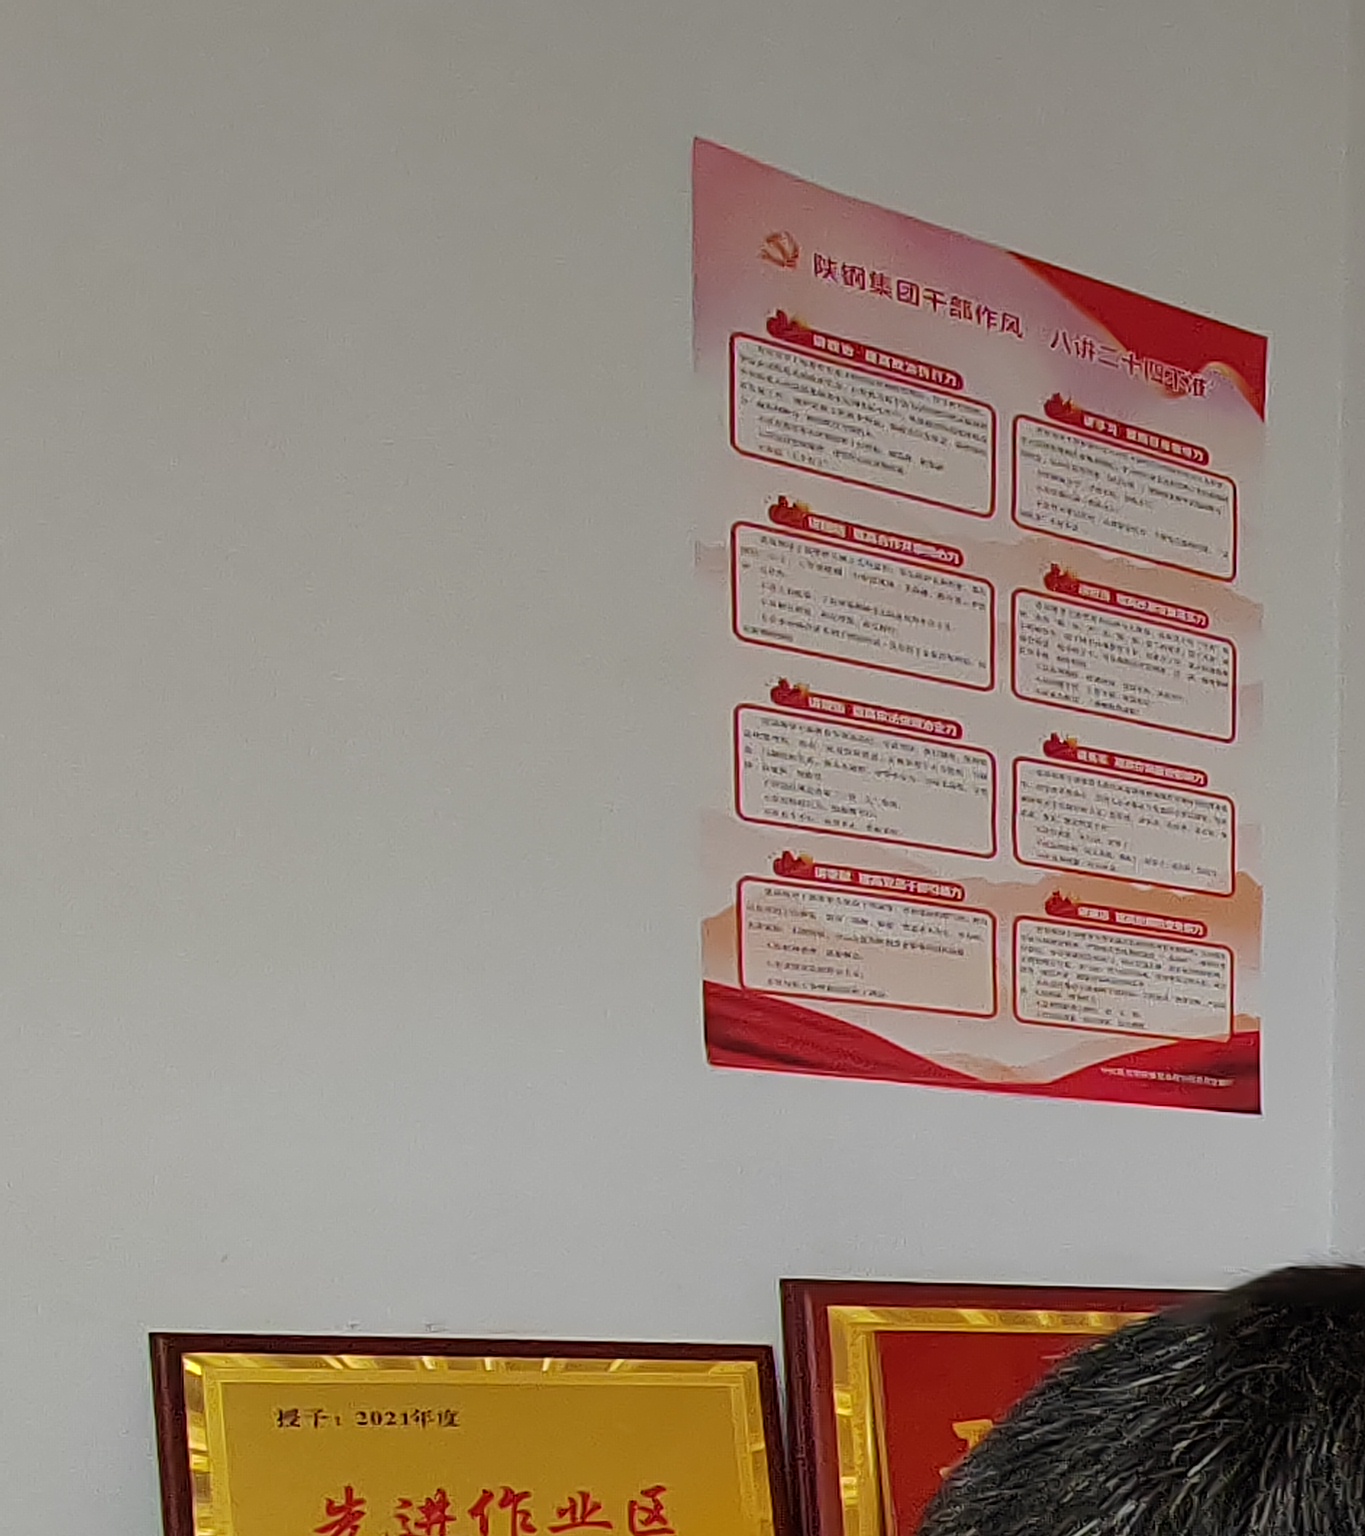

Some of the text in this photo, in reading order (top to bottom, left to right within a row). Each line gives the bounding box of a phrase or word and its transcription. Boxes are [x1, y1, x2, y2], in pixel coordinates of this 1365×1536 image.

[813, 252, 1024, 339] 陕钢集团干部作风
